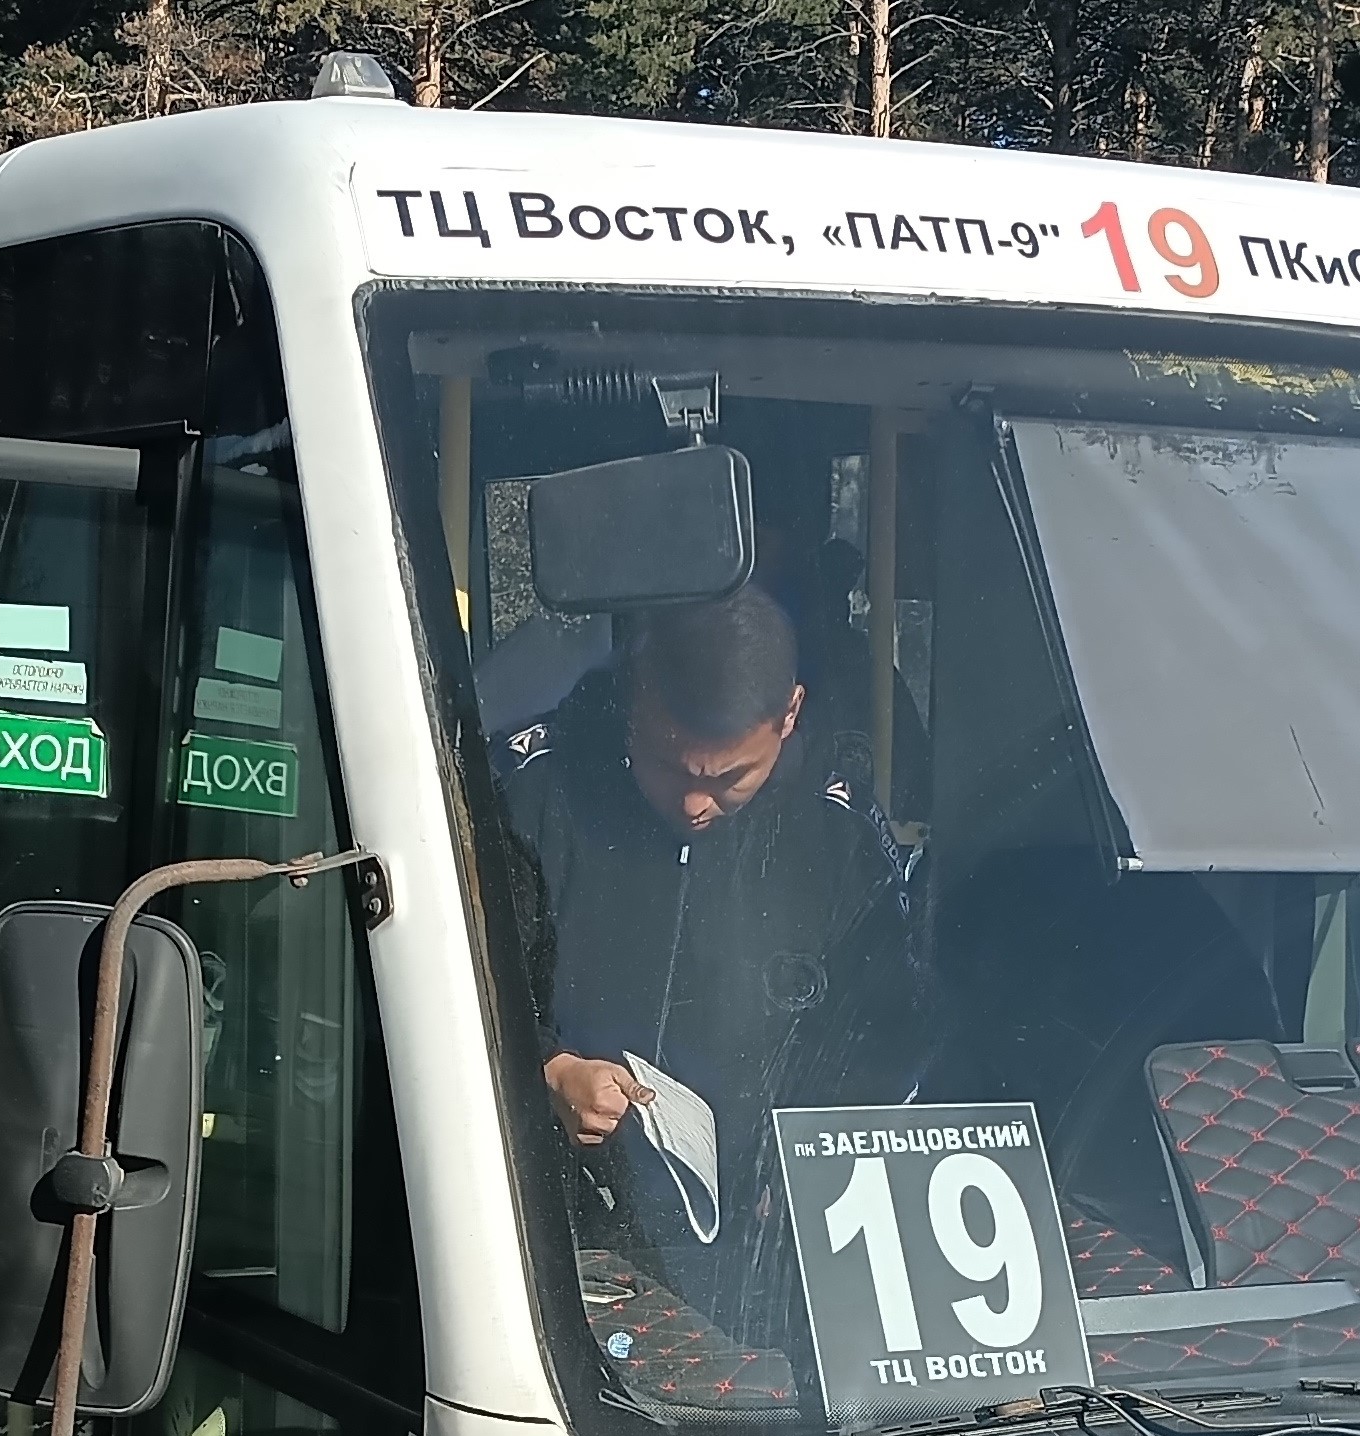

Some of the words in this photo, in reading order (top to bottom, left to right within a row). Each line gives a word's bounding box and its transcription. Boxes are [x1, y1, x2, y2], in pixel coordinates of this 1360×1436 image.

[376, 188, 492, 248] ТЦ
[509, 190, 795, 255] Восток,
[1080, 201, 1221, 299] 19
[819, 1121, 1030, 1156] ЗАЕЛЬЦОВСКИЙ
[824, 1153, 1042, 1352] 19
[870, 1359, 917, 1386] ТЦ
[926, 1350, 1047, 1380] ВОСТОК
